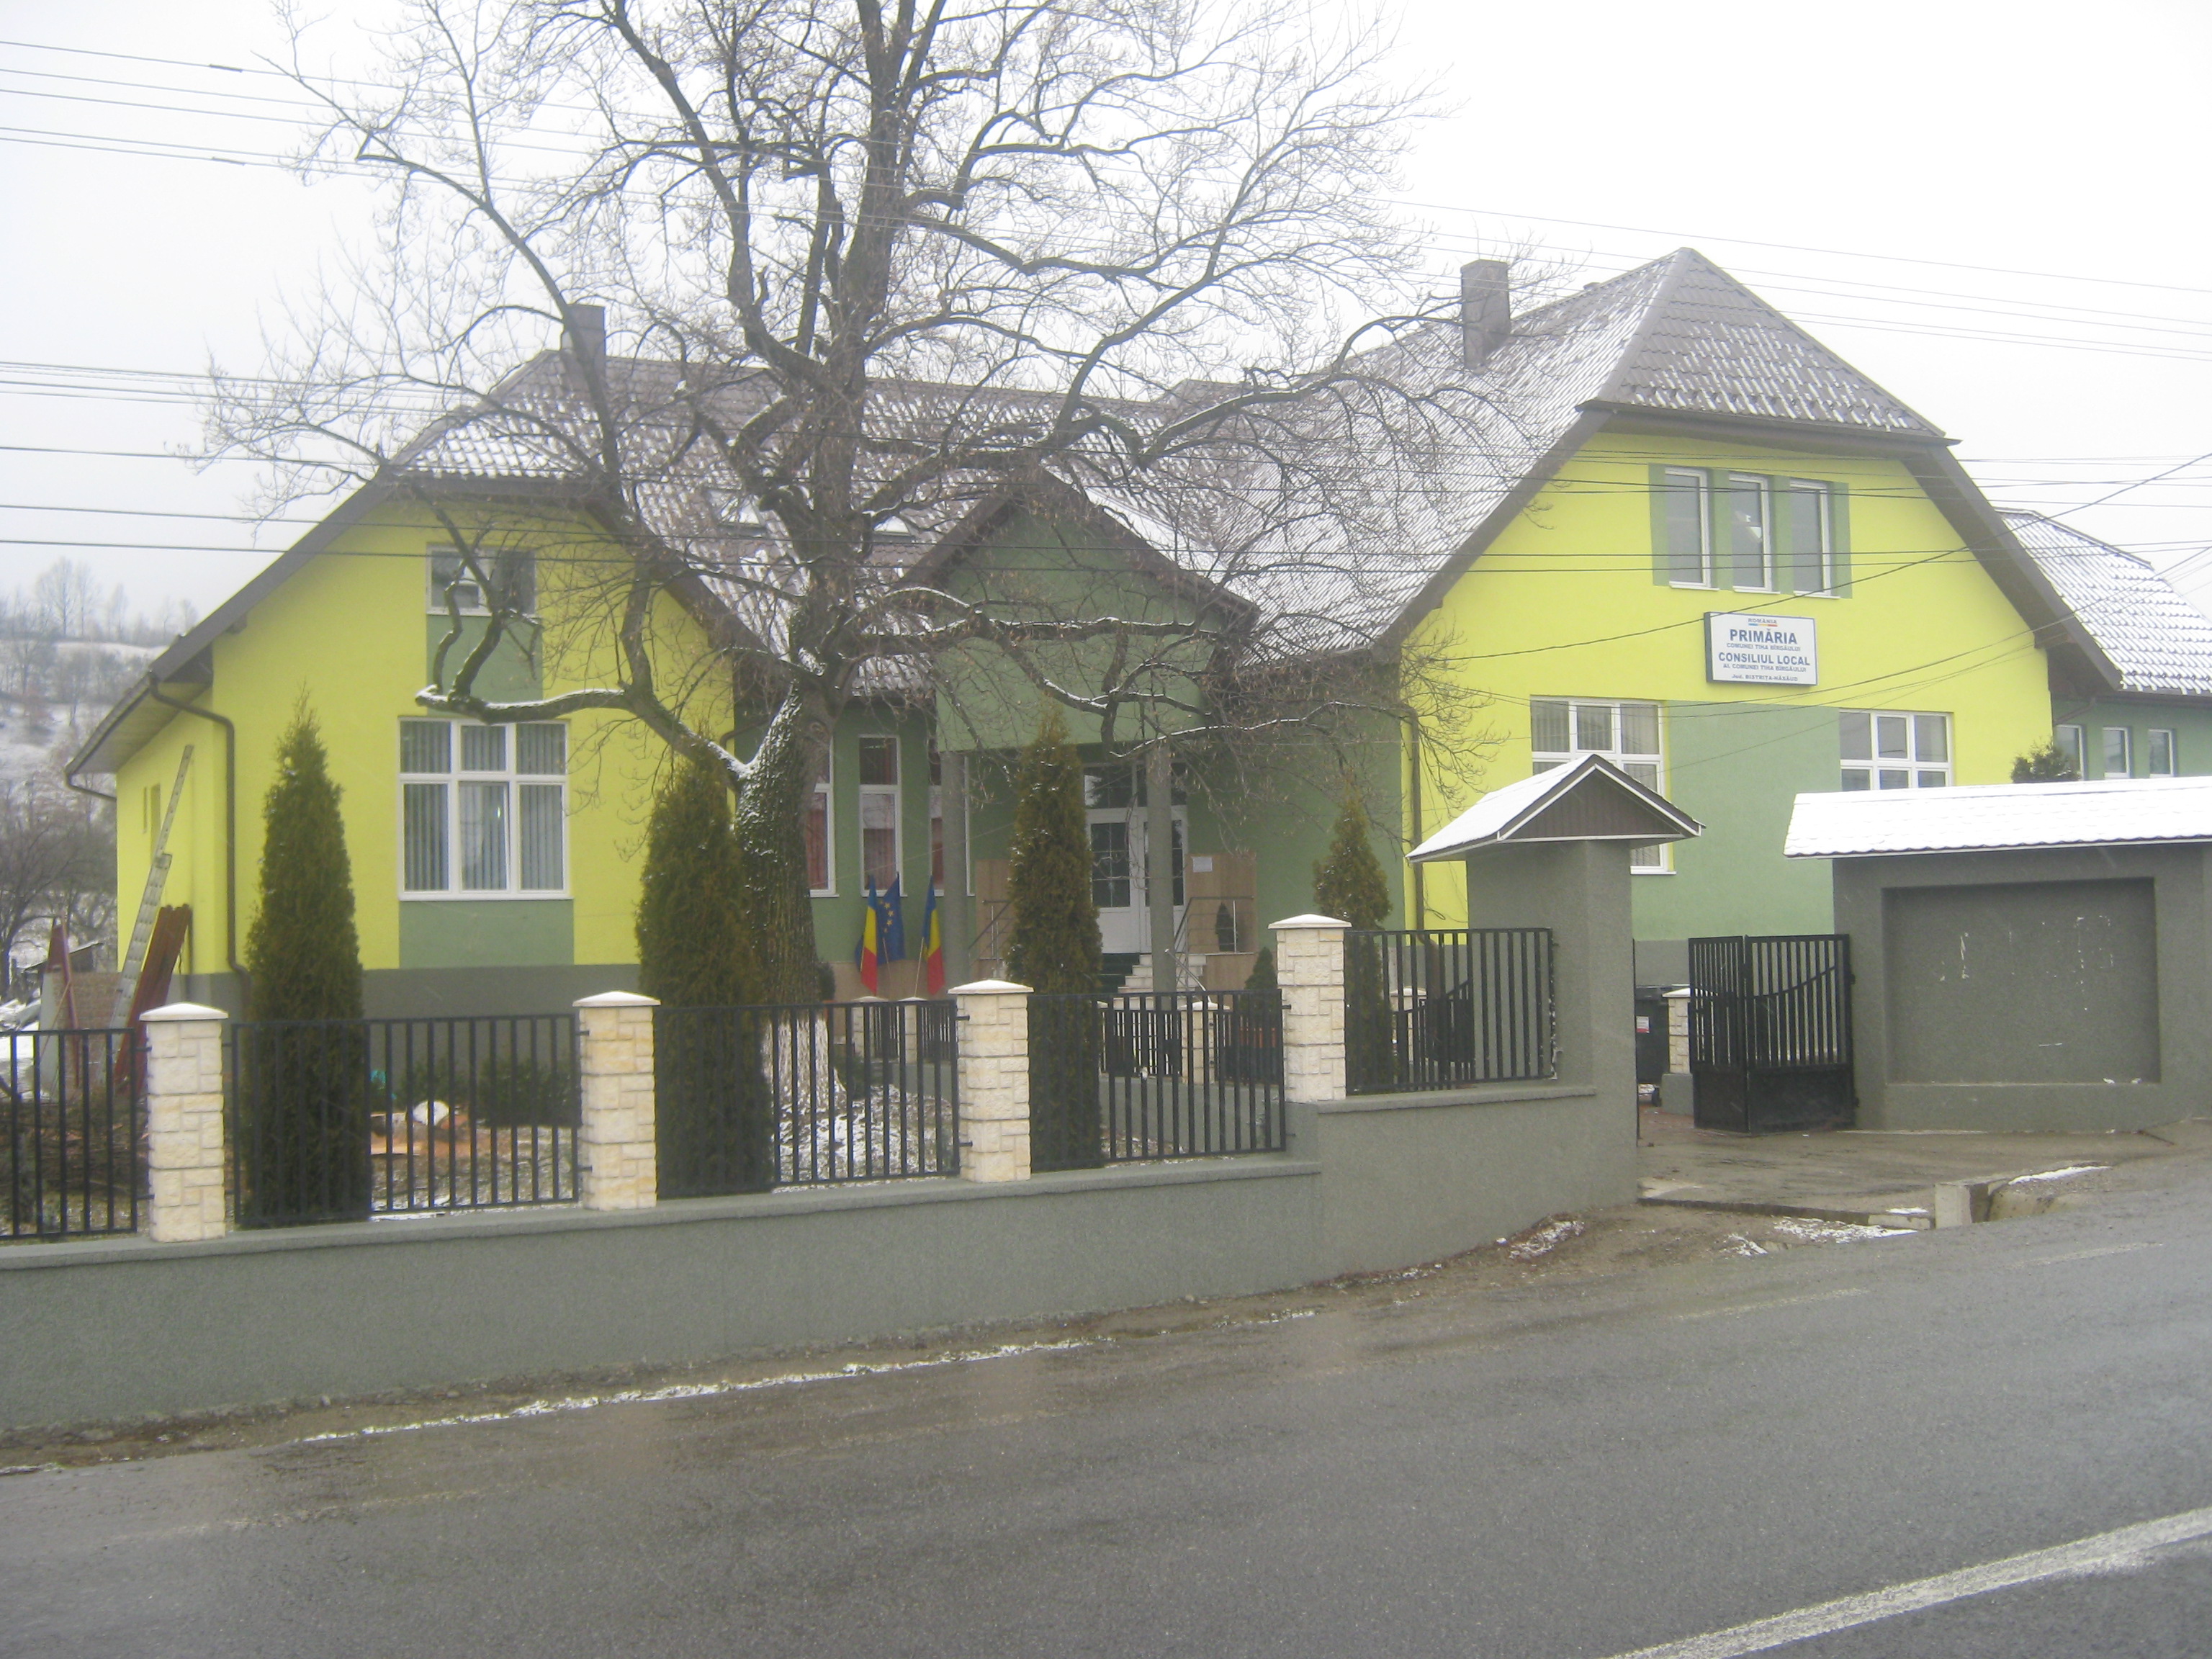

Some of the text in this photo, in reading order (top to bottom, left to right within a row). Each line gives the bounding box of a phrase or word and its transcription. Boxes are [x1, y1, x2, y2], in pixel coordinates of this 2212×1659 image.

[1730, 628, 1797, 644] PRIMĂRIA
[1719, 652, 1810, 666] CONSILIUL LOCAL
